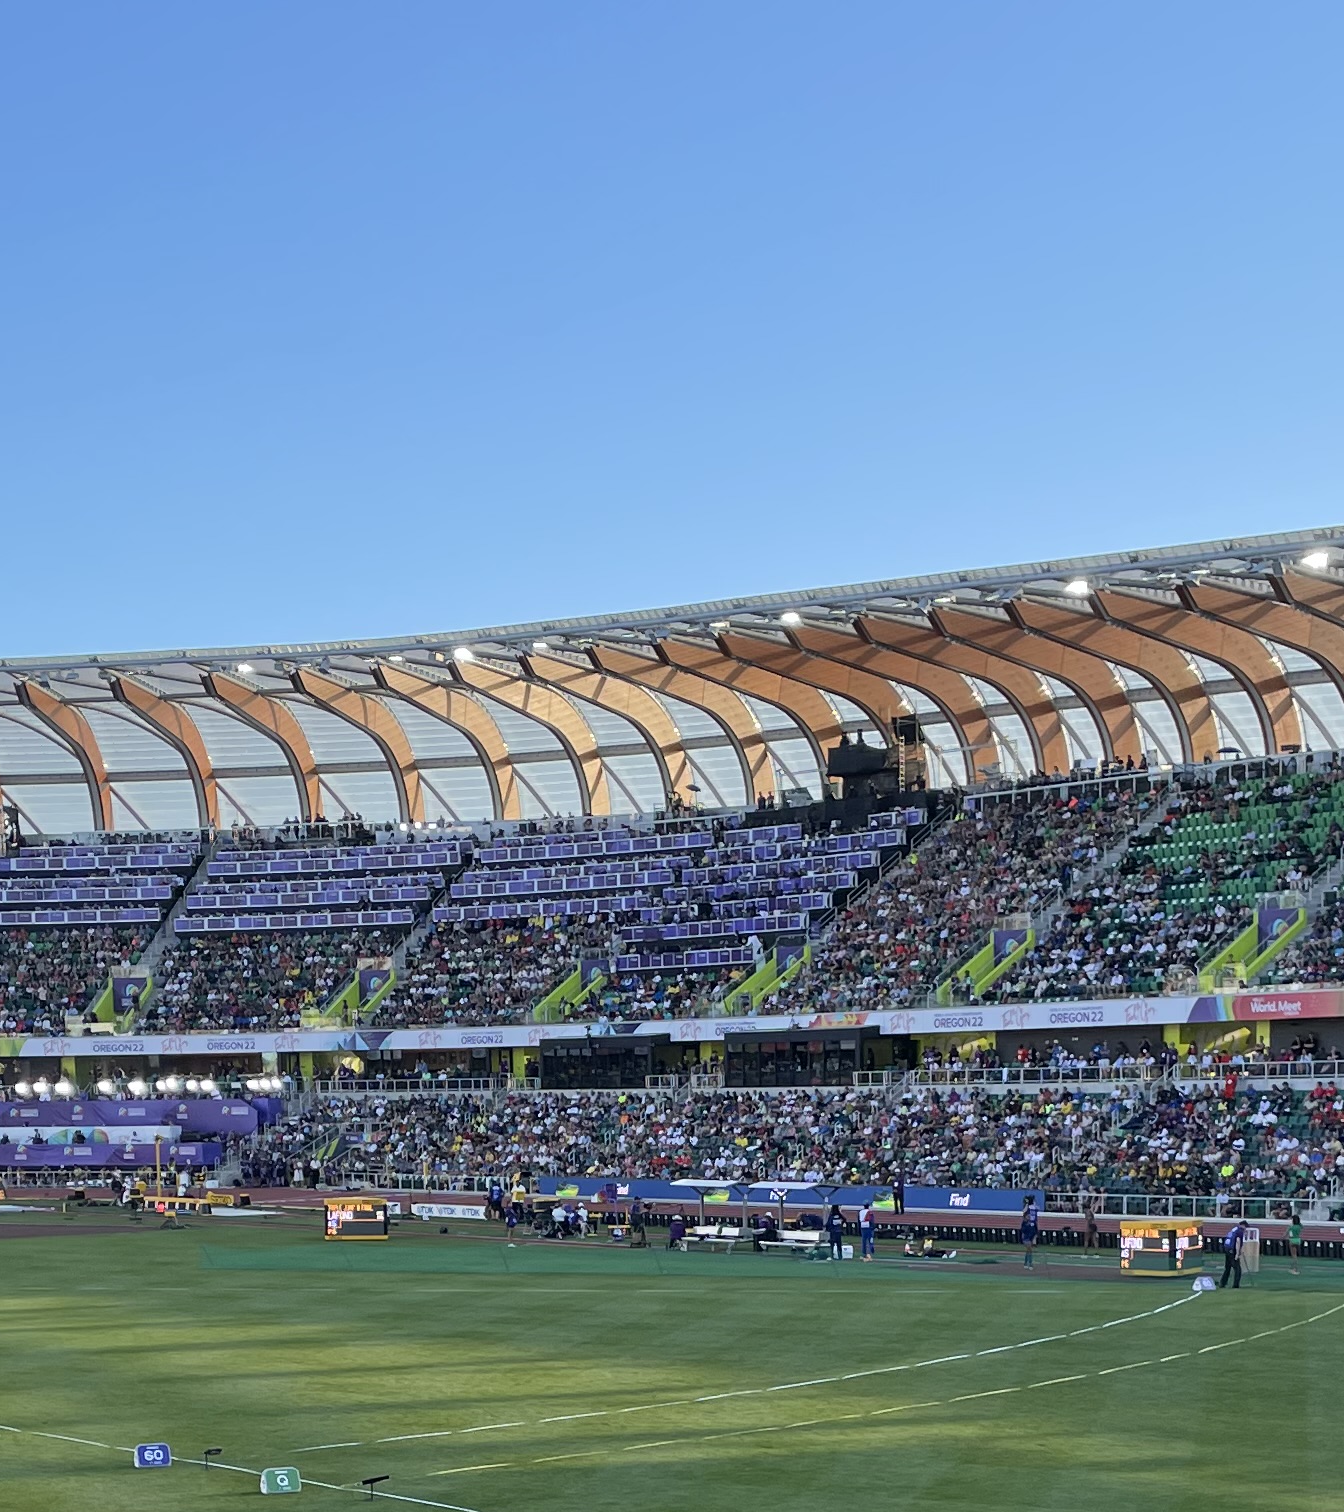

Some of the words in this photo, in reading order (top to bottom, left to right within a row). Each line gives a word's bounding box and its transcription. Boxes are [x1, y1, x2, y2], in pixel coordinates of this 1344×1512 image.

[1278, 1000, 1302, 1012] Meet
[934, 1017, 970, 1028] OREGON
[971, 1016, 984, 1027] 22
[1050, 1013, 1090, 1024] OREGON
[1091, 1011, 1104, 1022] 22
[207, 1041, 243, 1050] OREGON
[244, 1040, 256, 1050] 22
[461, 1036, 493, 1045] OREGON
[494, 1035, 504, 1044] 22
[92, 1043, 131, 1053] OREGON
[132, 1043, 144, 1052] 22
[949, 1193, 970, 1207] Find
[144, 1450, 164, 1461] 60
[276, 1475, 289, 1486] Q
